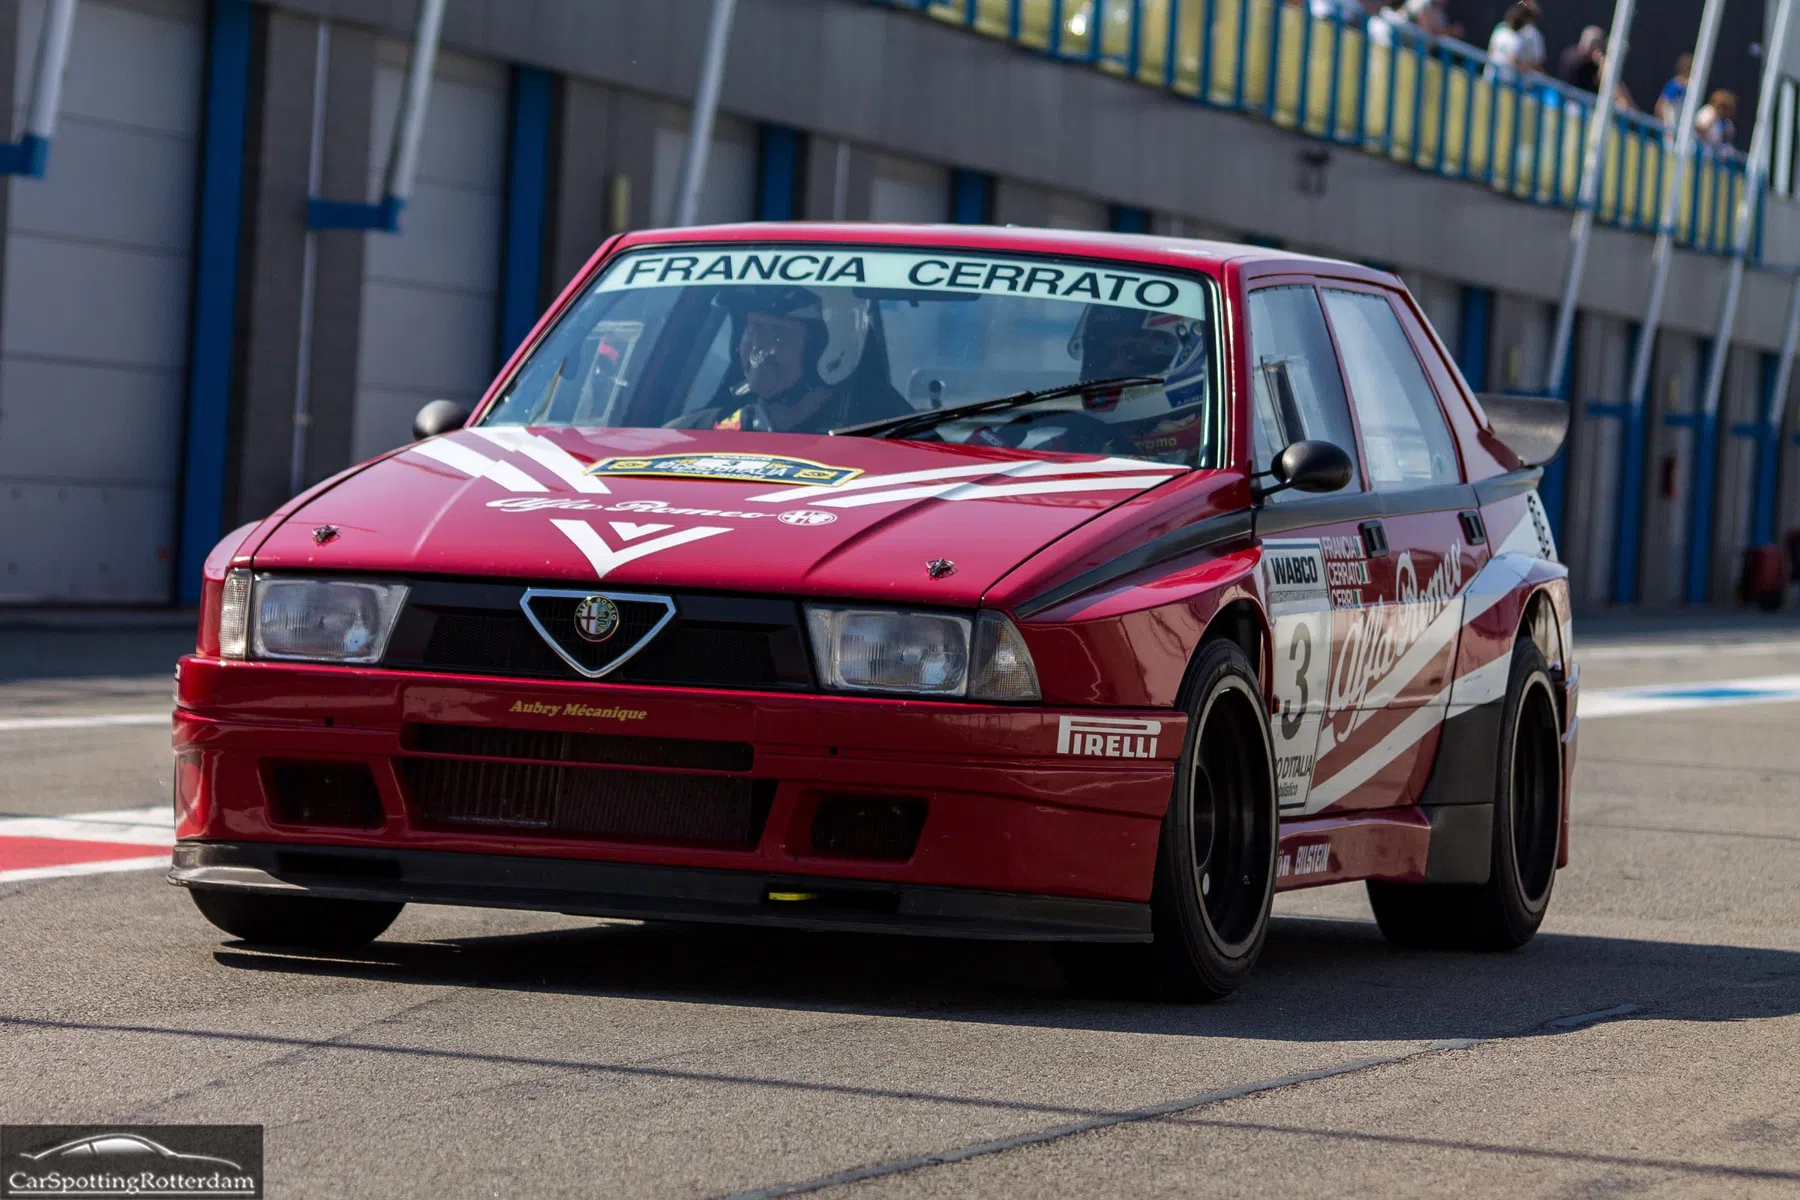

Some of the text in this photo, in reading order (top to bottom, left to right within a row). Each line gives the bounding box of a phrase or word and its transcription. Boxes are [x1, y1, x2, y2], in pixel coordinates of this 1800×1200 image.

[623, 254, 1180, 308] FRANCIA CERRATO
[604, 499, 777, 520] Romeo
[1321, 535, 1356, 559] FRANCIA
[1270, 556, 1318, 585] WABCO
[1327, 561, 1363, 586] CERRATO
[576, 597, 617, 621] ALFA ROMEO
[1331, 589, 1355, 610] CERRI
[1395, 537, 1463, 657] Romeo
[1280, 621, 1311, 741] 3
[509, 699, 647, 722] Aubry Mécanique
[1056, 715, 1161, 759] PIRELLI
[1294, 843, 1331, 875] BILSTEIN
